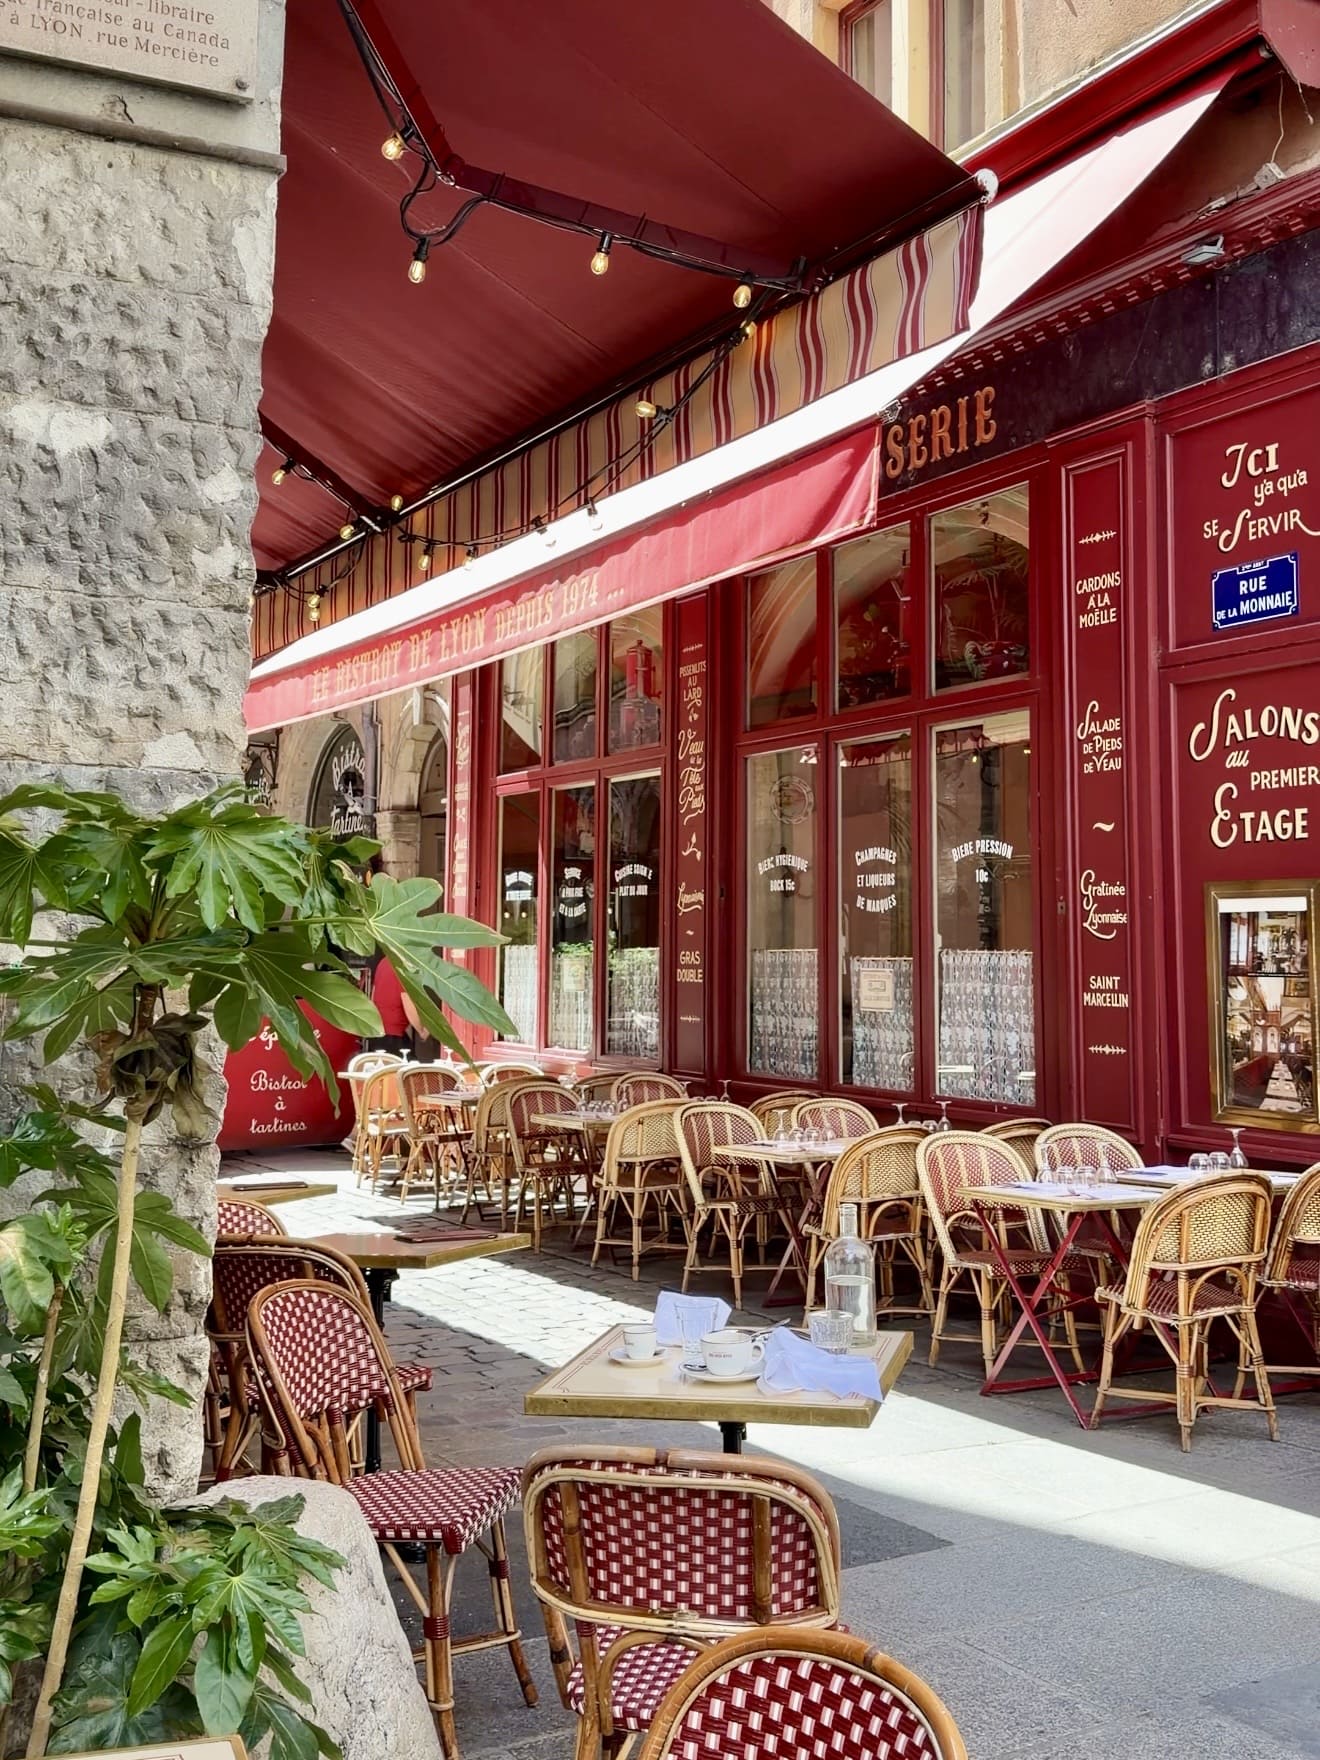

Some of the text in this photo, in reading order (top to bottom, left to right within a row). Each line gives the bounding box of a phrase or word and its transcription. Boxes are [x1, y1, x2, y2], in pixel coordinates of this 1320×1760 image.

[10, 10, 20, 26] à
[97, 31, 129, 48] rue
[135, 36, 219, 67] Mercière
[132, 17, 154, 34] au
[163, 23, 230, 50] Canada
[1203, 519, 1219, 539] SE
[1076, 571, 1121, 595] CARDONS
[1239, 575, 1268, 595] RUE
[1097, 592, 1111, 607] LA
[1216, 590, 1293, 620] DE LA MONNAIE
[335, 640, 402, 697] BISTROT
[408, 628, 432, 673] DE
[439, 607, 487, 662] LYON
[495, 590, 554, 643] DEPUIS
[560, 574, 599, 620] 1974
[687, 674, 698, 688] AU
[1083, 743, 1093, 755] DE
[1083, 762, 1094, 774] DE
[1225, 750, 1249, 769] au
[1250, 765, 1320, 791] PREMIER
[1210, 782, 1309, 849] ETAGE
[855, 846, 897, 866] CHAMPAGNES
[951, 839, 1014, 863] BIERE PRESSION
[856, 872, 896, 889] ET LIQUEURS
[1080, 869, 1126, 911] Gratinée
[856, 893, 897, 914] DE MARQUES
[1082, 903, 1128, 939] Lyonnaise
[680, 951, 701, 965] GRAS
[677, 968, 703, 983] DOUBLE
[1089, 975, 1121, 990] SAINT
[1083, 992, 1129, 1008] MARCELLIN
[274, 1096, 287, 1111] à
[249, 1118, 307, 1134] tartines
